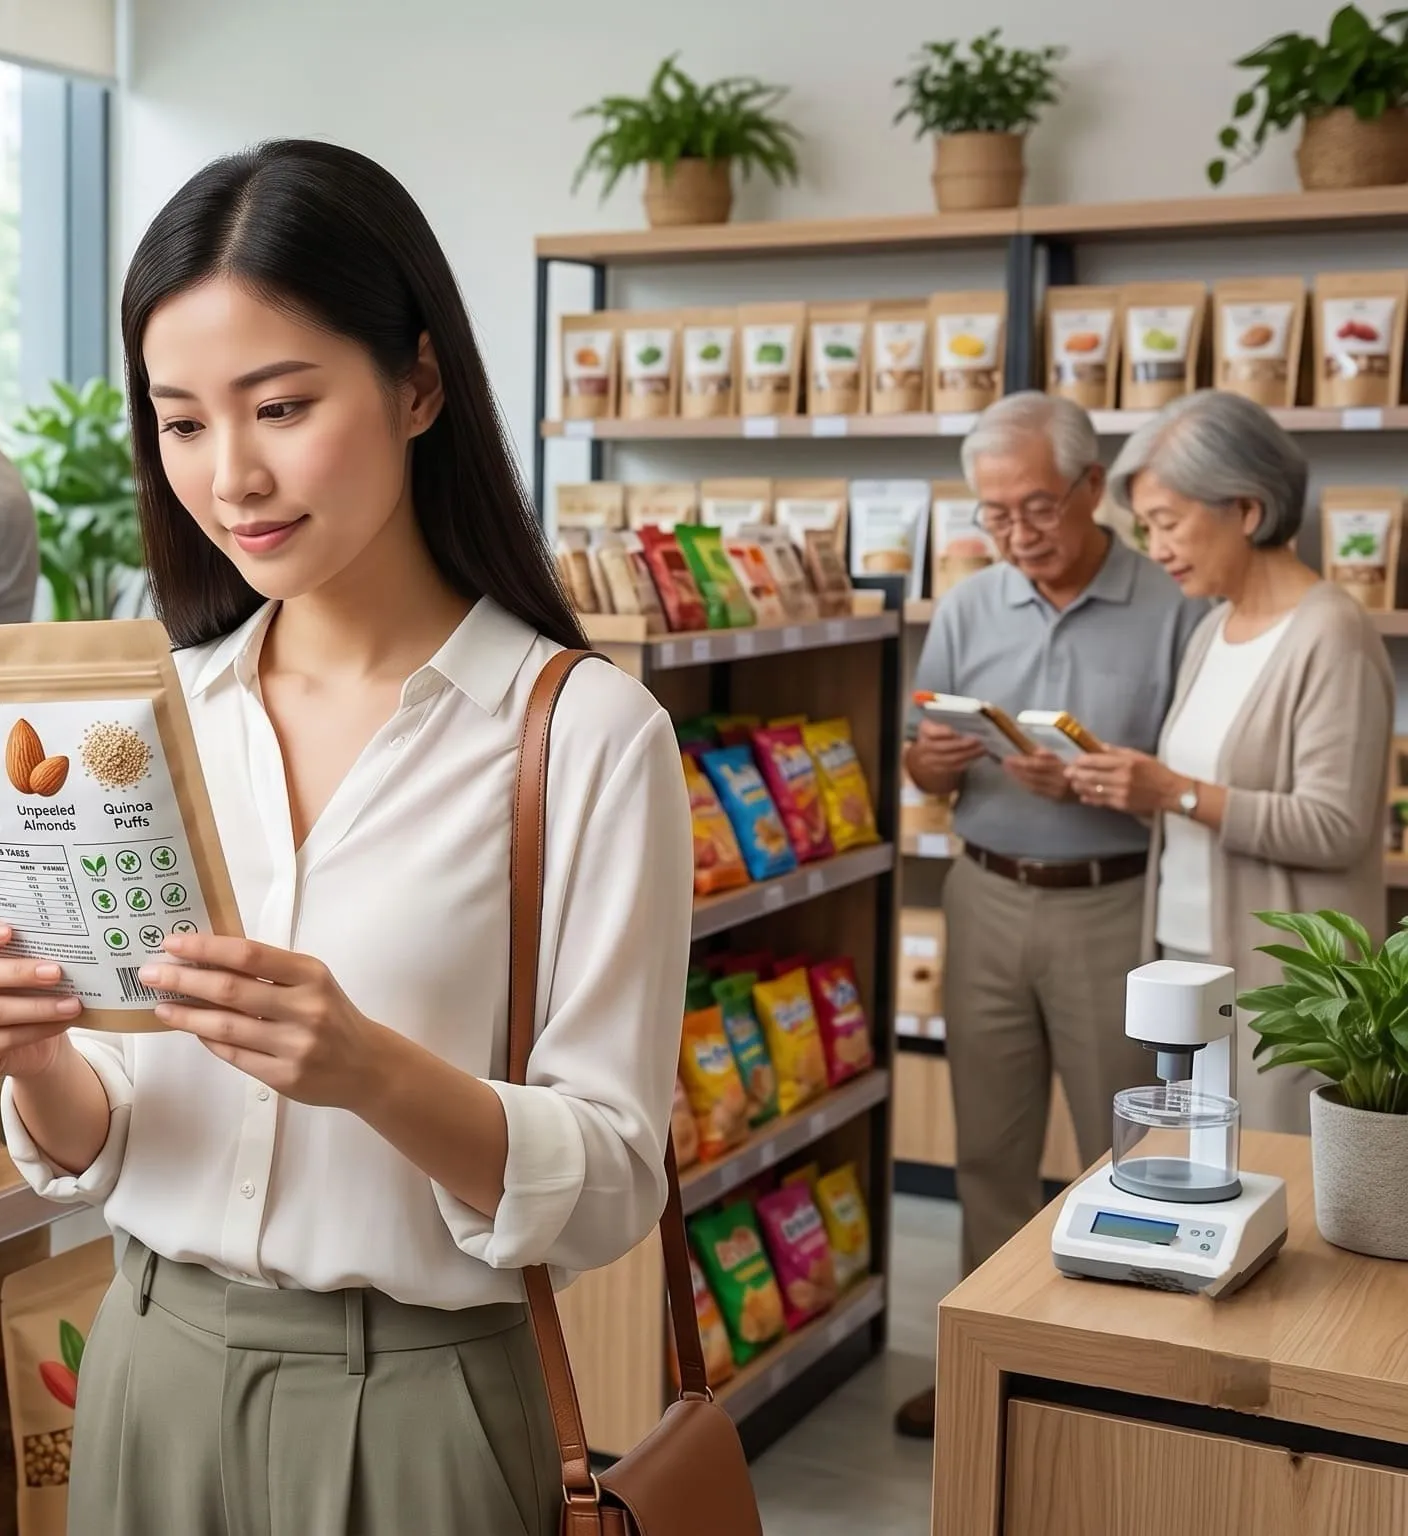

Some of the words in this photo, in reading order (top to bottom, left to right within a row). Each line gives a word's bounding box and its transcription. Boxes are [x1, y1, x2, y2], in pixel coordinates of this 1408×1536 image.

[16, 804, 76, 819] Unpeeled
[103, 802, 153, 815] Quinoa
[24, 819, 77, 831] Almonds
[113, 815, 150, 829] Puffs
